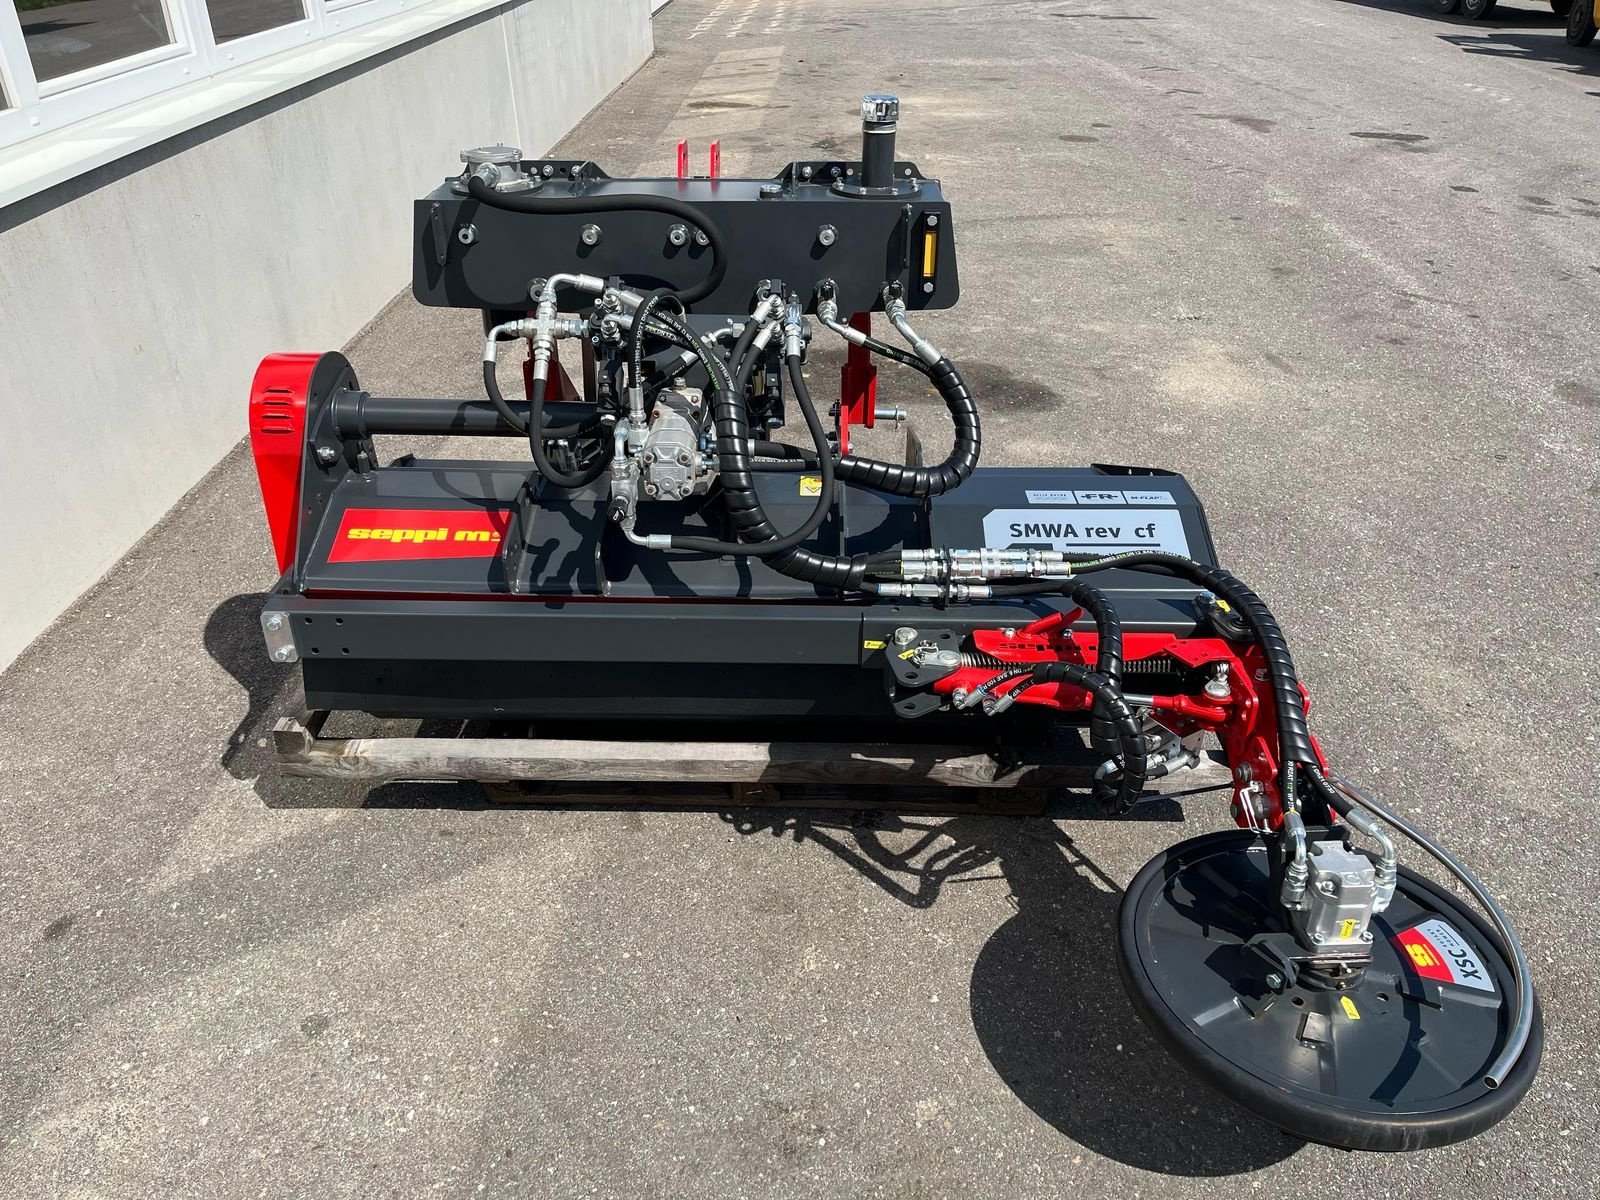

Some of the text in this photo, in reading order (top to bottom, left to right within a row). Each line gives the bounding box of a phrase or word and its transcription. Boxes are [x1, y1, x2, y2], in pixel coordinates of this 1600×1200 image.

[347, 528, 449, 543] seppi
[1009, 523, 1156, 539] SMWA rev cf
[988, 677, 997, 687] 100
[996, 672, 1008, 682] SAE
[1287, 793, 1294, 801] WP
[1426, 928, 1448, 948] ROTARY
[1435, 929, 1455, 947] MOWER
[1447, 948, 1483, 981] XSC
